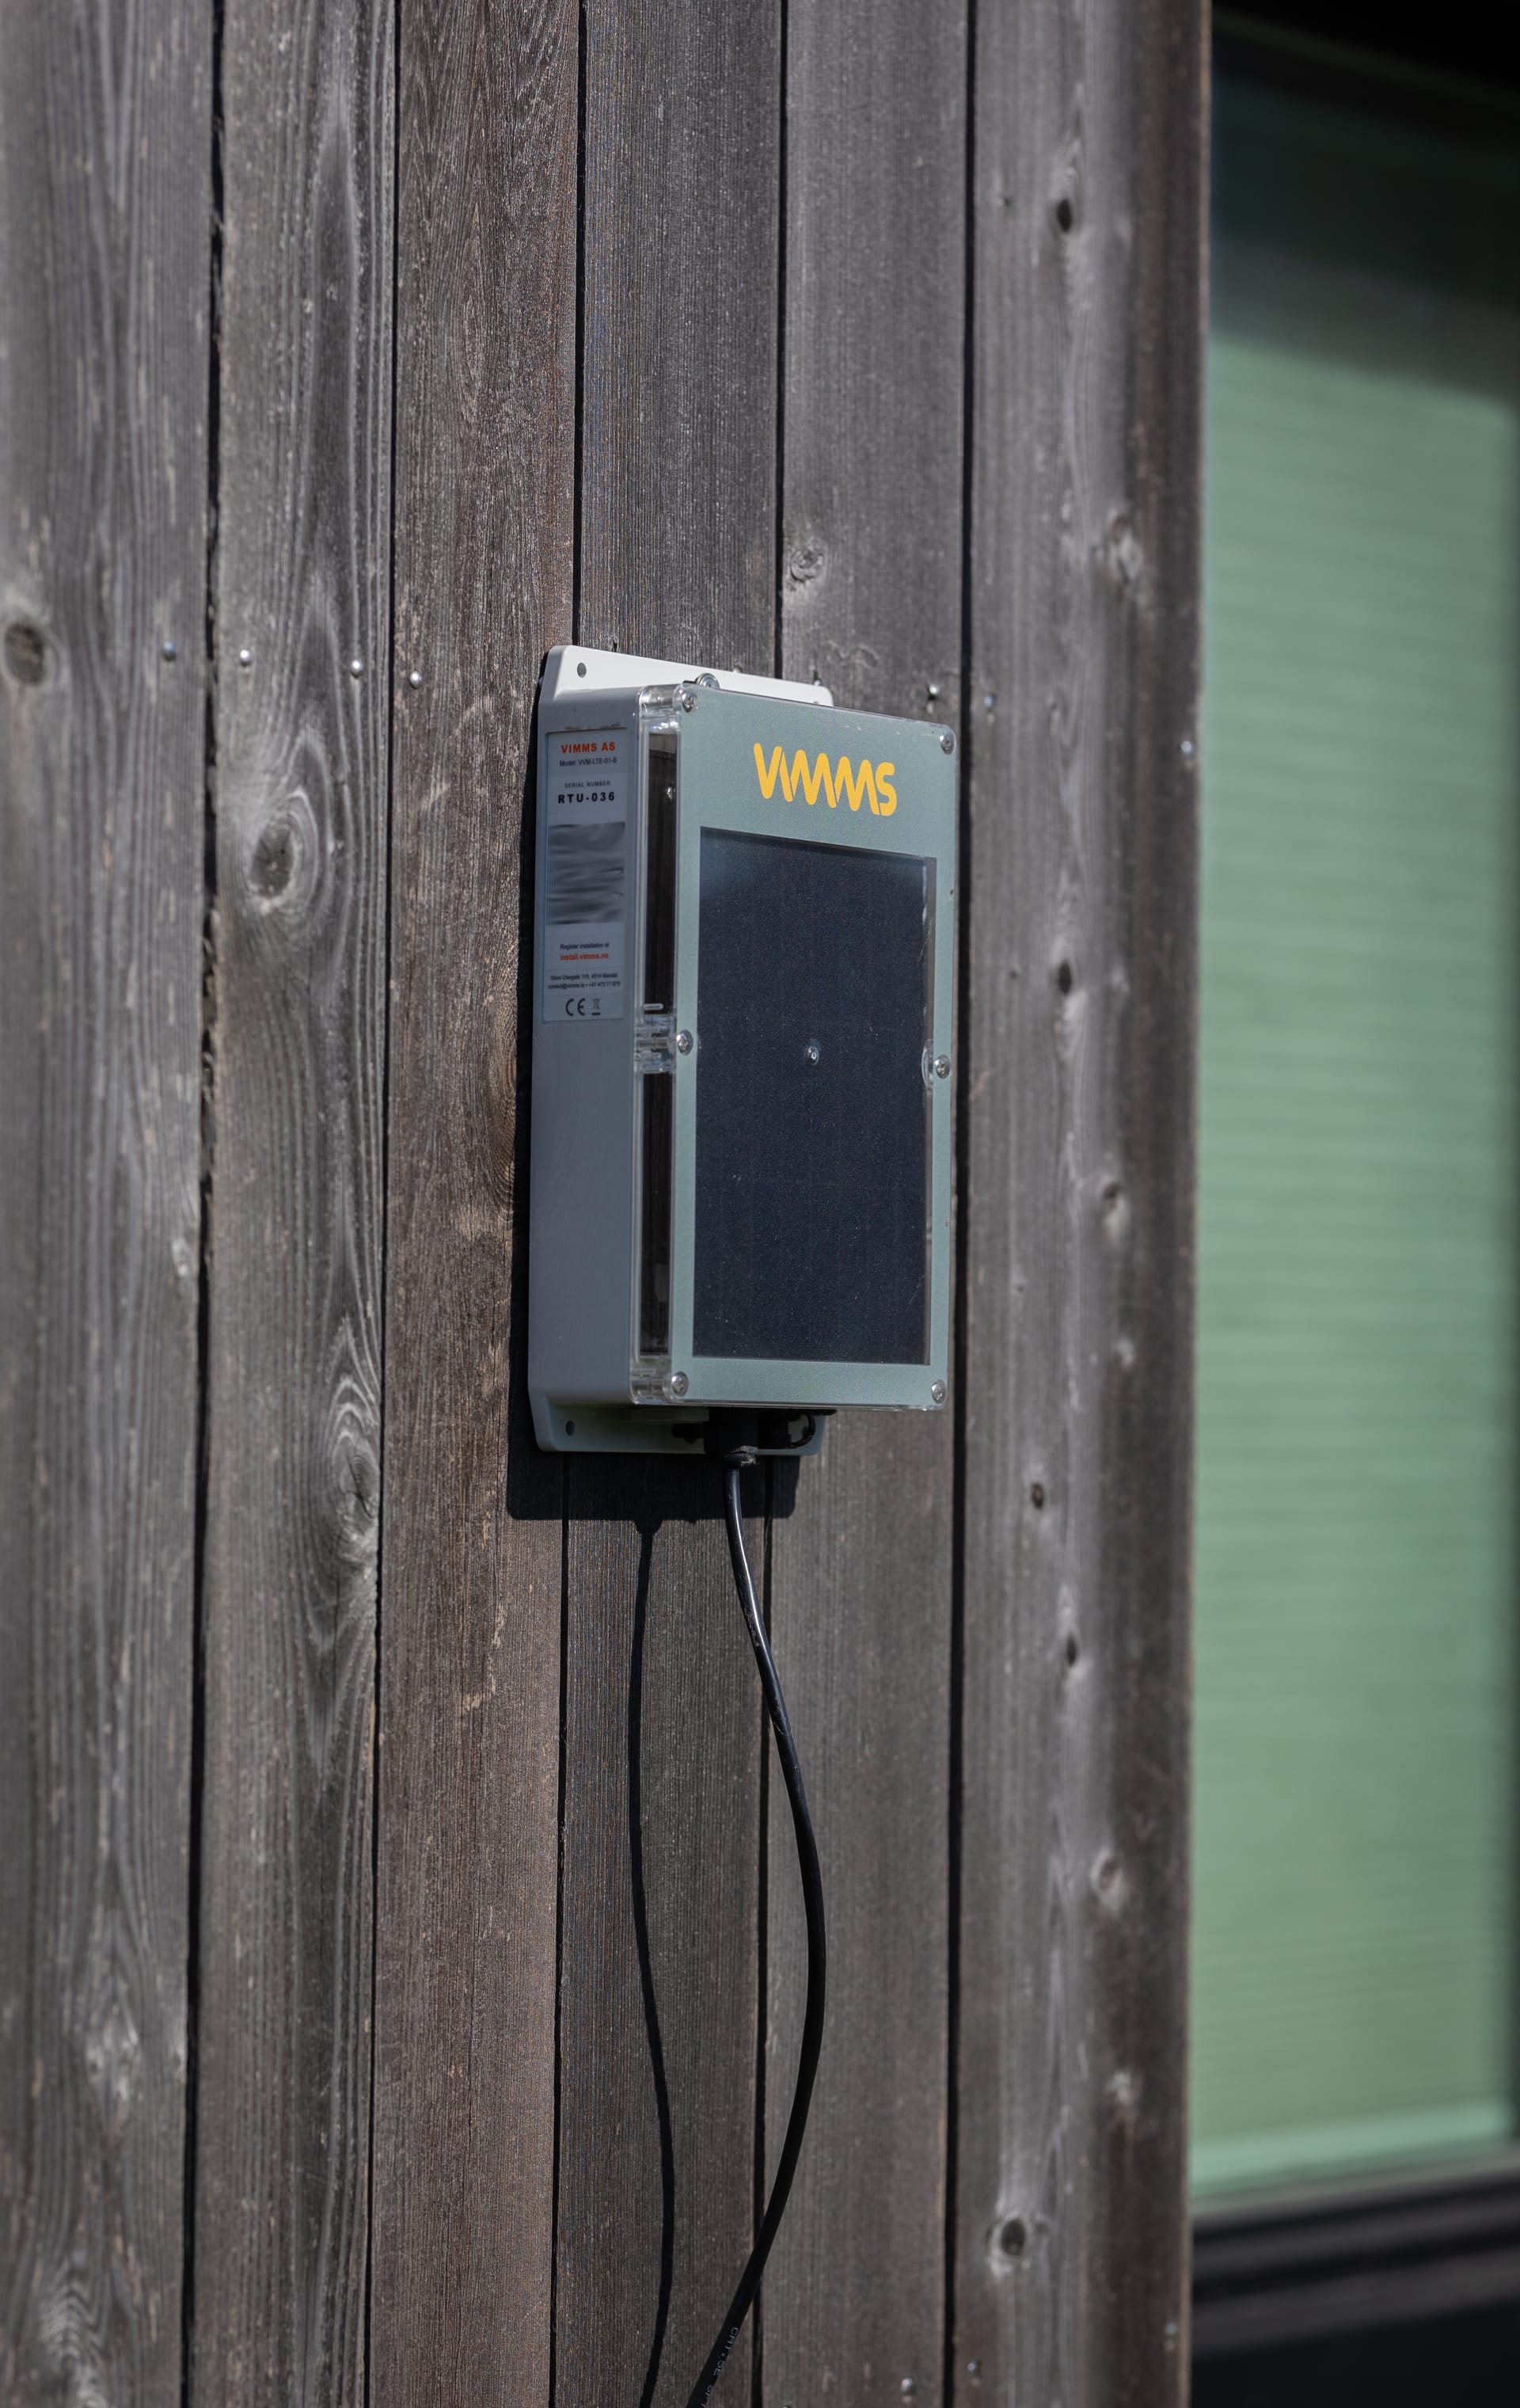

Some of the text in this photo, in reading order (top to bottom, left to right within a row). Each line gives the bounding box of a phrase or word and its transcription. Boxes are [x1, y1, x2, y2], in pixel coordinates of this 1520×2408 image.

[561, 741, 615, 754] VIMMS AS
[754, 742, 897, 816] VIMMS
[558, 791, 615, 804] RTU-036
